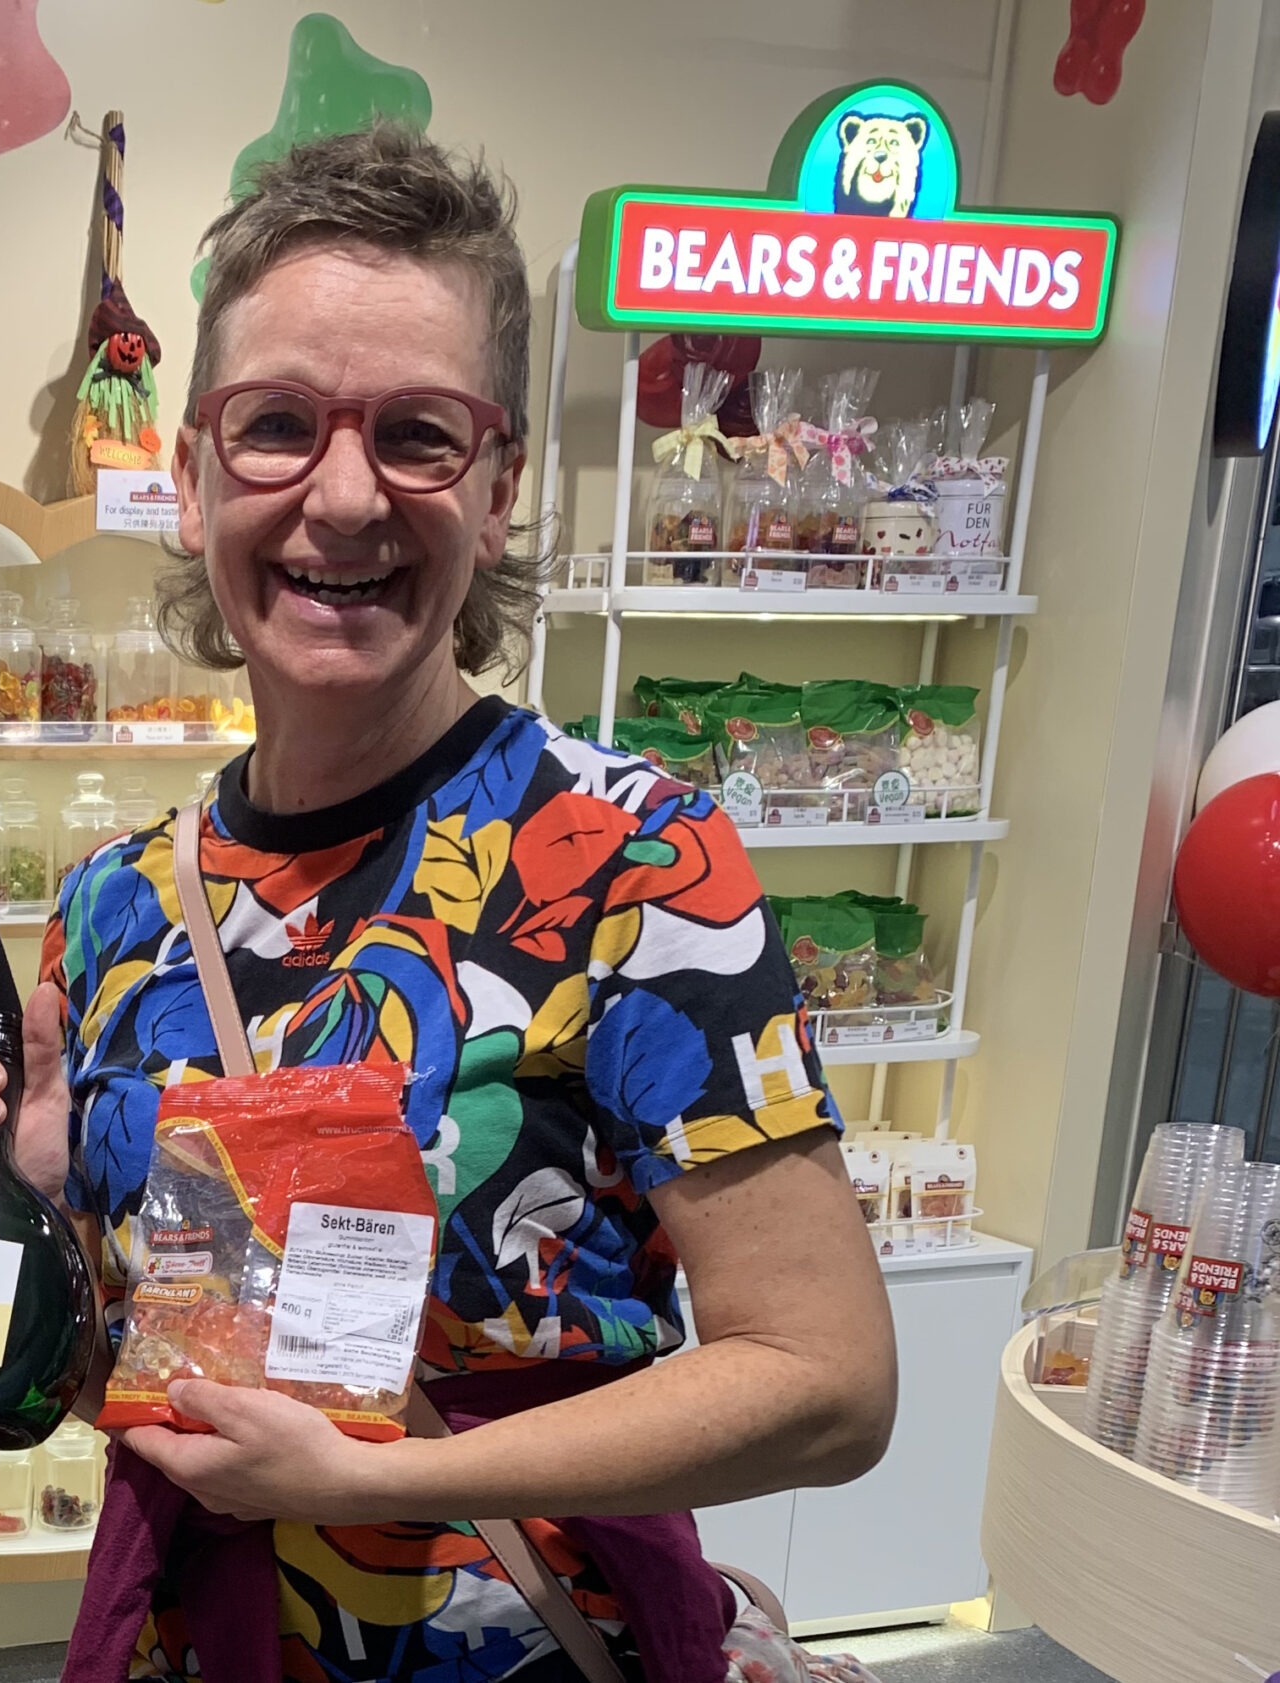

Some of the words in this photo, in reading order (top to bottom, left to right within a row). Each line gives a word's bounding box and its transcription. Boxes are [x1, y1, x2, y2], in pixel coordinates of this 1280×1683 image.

[639, 226, 818, 298] BEARS
[822, 237, 863, 300] &
[868, 240, 1084, 310] FRIENDS
[100, 445, 142, 465] WELCOME
[104, 505, 118, 514] For
[119, 505, 144, 516] display
[146, 507, 160, 516] and
[967, 501, 991, 515] FÜR
[966, 517, 990, 529] DEN
[726, 786, 752, 806] Vegan
[879, 792, 904, 804] Vegan
[282, 952, 330, 967] adidas
[321, 1214, 395, 1235] Sekt-Bären
[154, 1233, 178, 1241] BEARS
[184, 1231, 210, 1240] FRIENDS
[1192, 1261, 1240, 1279] FRIENDS
[1197, 1275, 1237, 1290] BEARS
[281, 1302, 301, 1316] 500
